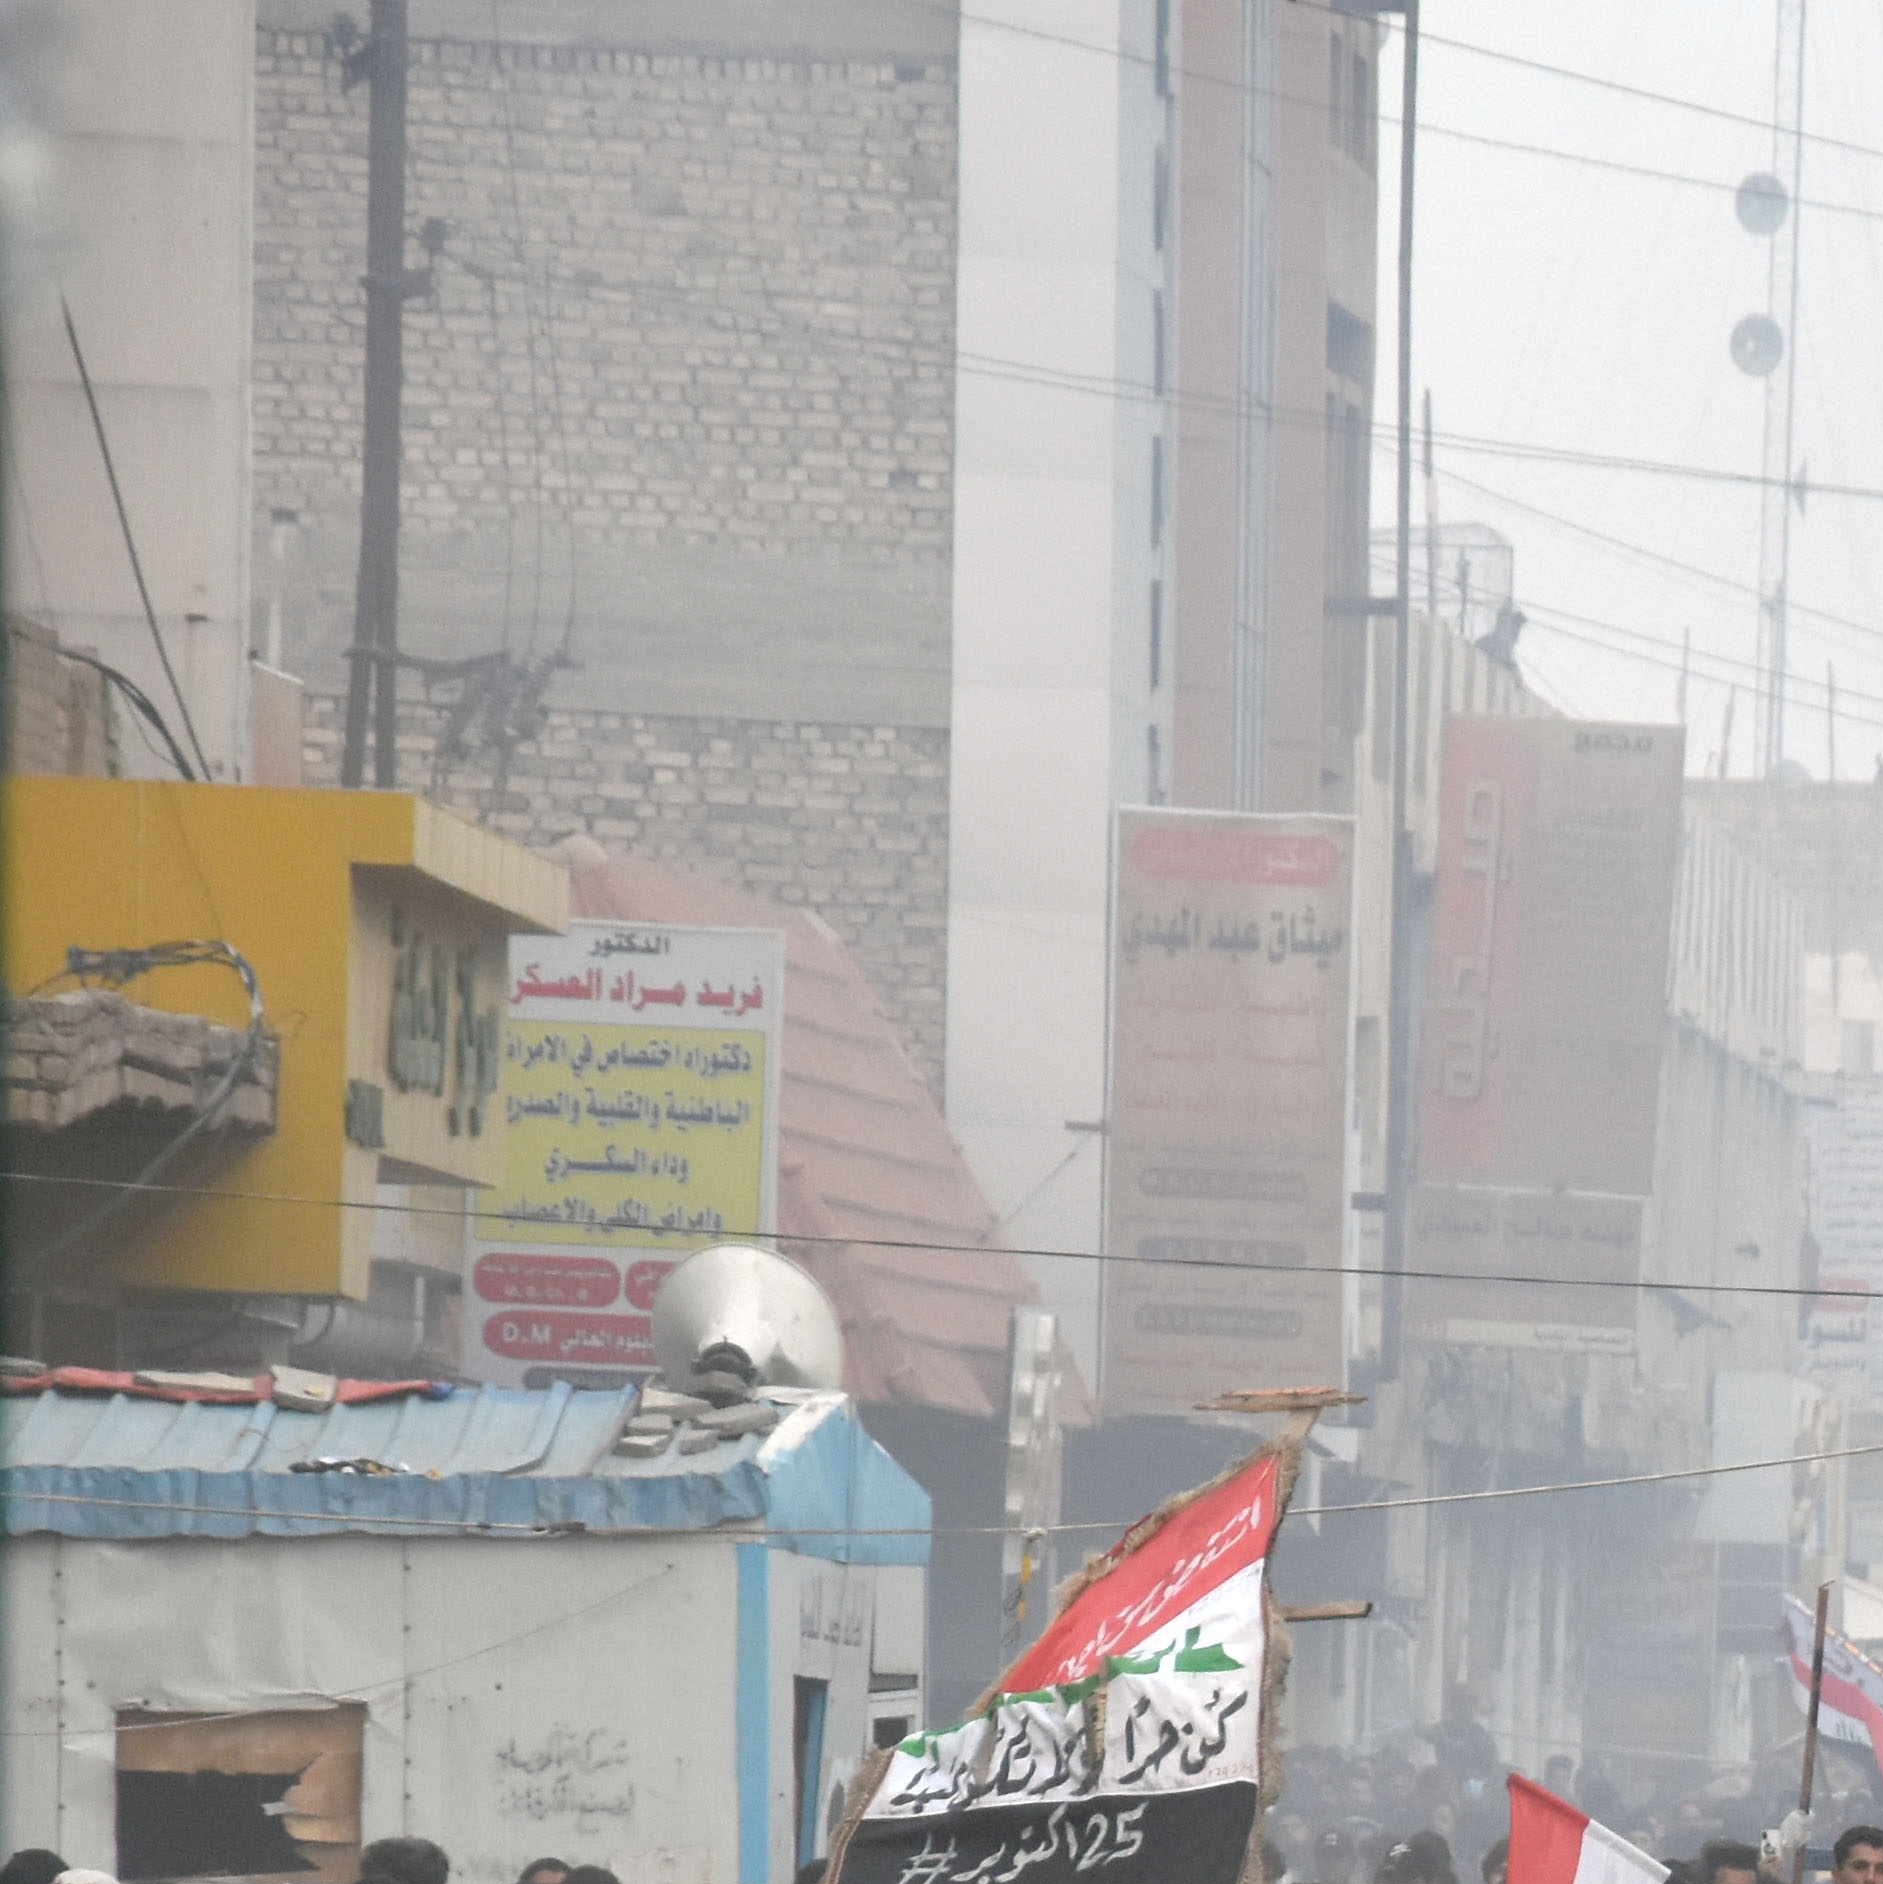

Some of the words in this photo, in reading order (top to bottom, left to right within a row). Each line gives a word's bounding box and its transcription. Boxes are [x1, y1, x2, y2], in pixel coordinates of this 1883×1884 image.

[588, 932, 670, 957] الدكتور
[1208, 908, 1261, 967] عبد
[1268, 903, 1345, 969] ميثاق
[509, 964, 602, 1003] العسكر
[697, 976, 763, 1016] فريد
[570, 1034, 592, 1077] في
